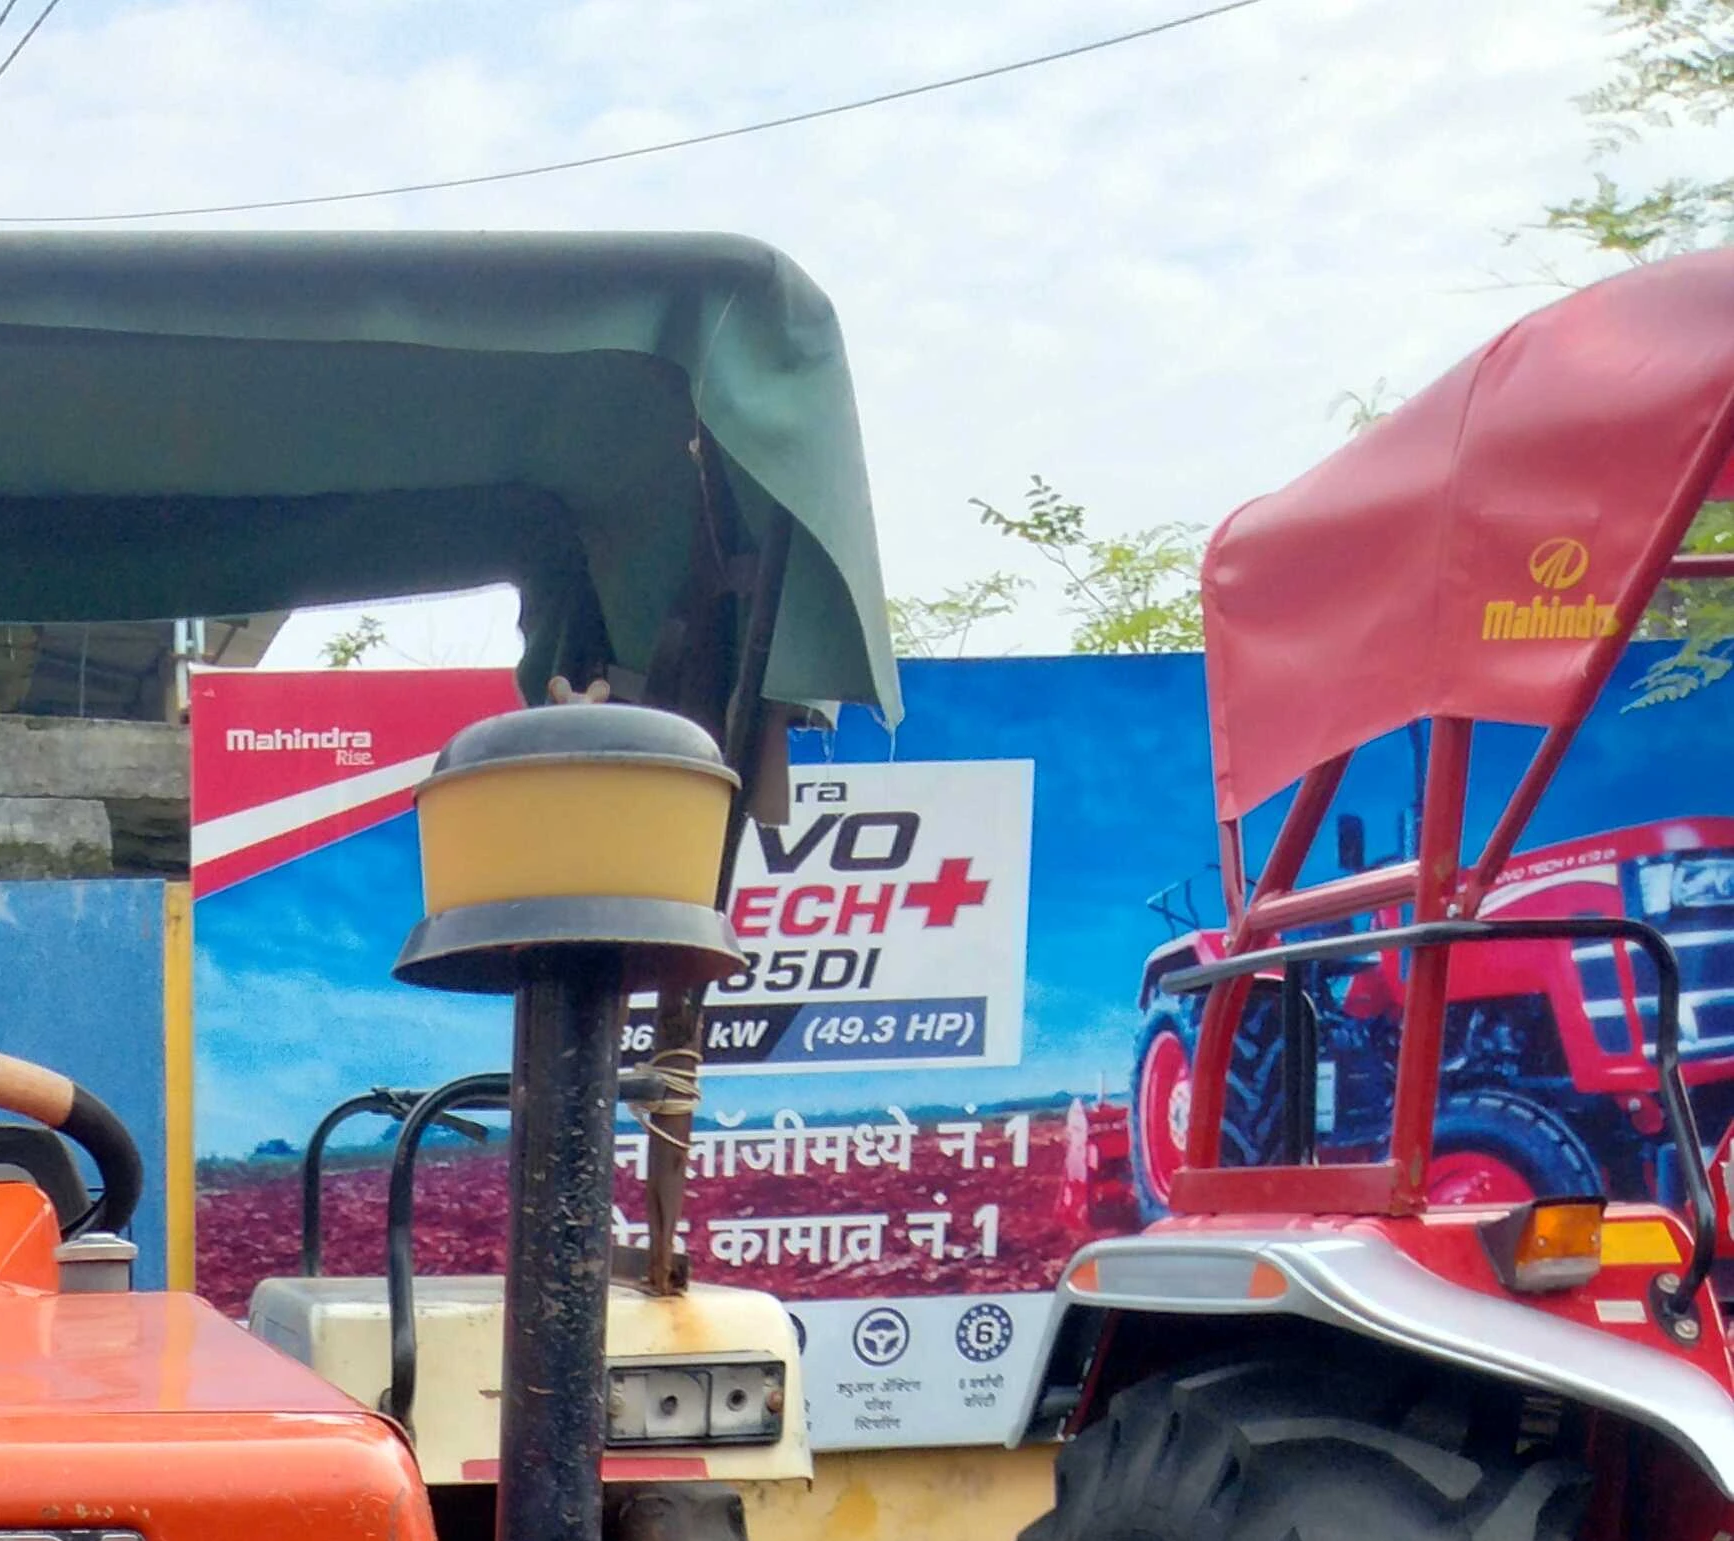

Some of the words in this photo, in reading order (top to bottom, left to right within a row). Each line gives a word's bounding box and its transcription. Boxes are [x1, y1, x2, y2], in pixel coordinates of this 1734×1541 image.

[226, 727, 372, 751] Mahindra
[754, 811, 921, 875] VO
[717, 947, 883, 993] 85DI
[708, 1020, 769, 1049] kW
[803, 1017, 898, 1053] (49.3
[904, 1012, 977, 1047] HP)
[707, 1214, 889, 1267] कामात
[975, 1321, 995, 1346] 6
